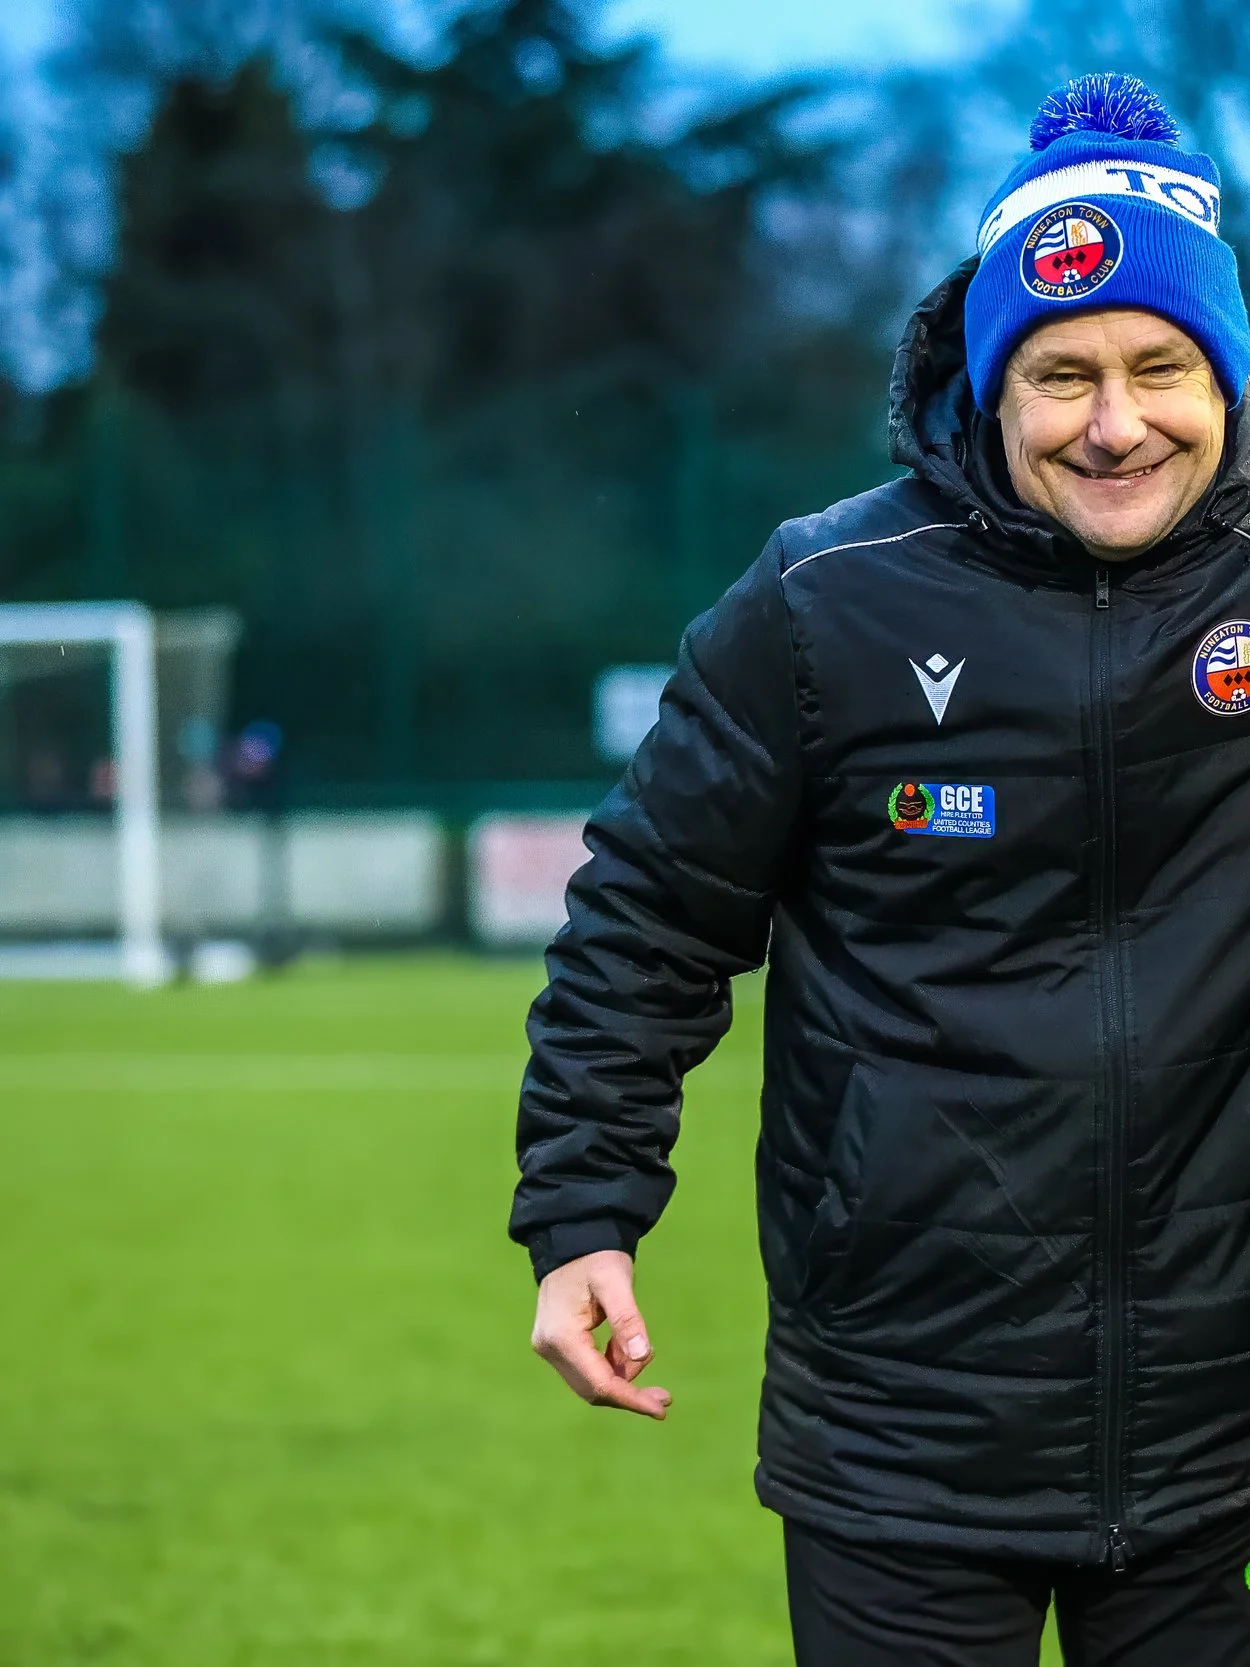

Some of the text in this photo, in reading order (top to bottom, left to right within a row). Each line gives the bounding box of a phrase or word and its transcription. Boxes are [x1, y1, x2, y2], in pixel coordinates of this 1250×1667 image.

[1026, 207, 1073, 249] NUNEATON
[1079, 207, 1109, 229] TOWN
[1031, 258, 1114, 296] FOOTBALL CLUB
[1199, 625, 1243, 659] NUNEATON
[1204, 691, 1249, 711] FOOTBALL
[940, 785, 984, 813] GCE
[932, 825, 992, 835] FOOTBALL LEAGUE
[957, 820, 991, 828] COUNTIES
